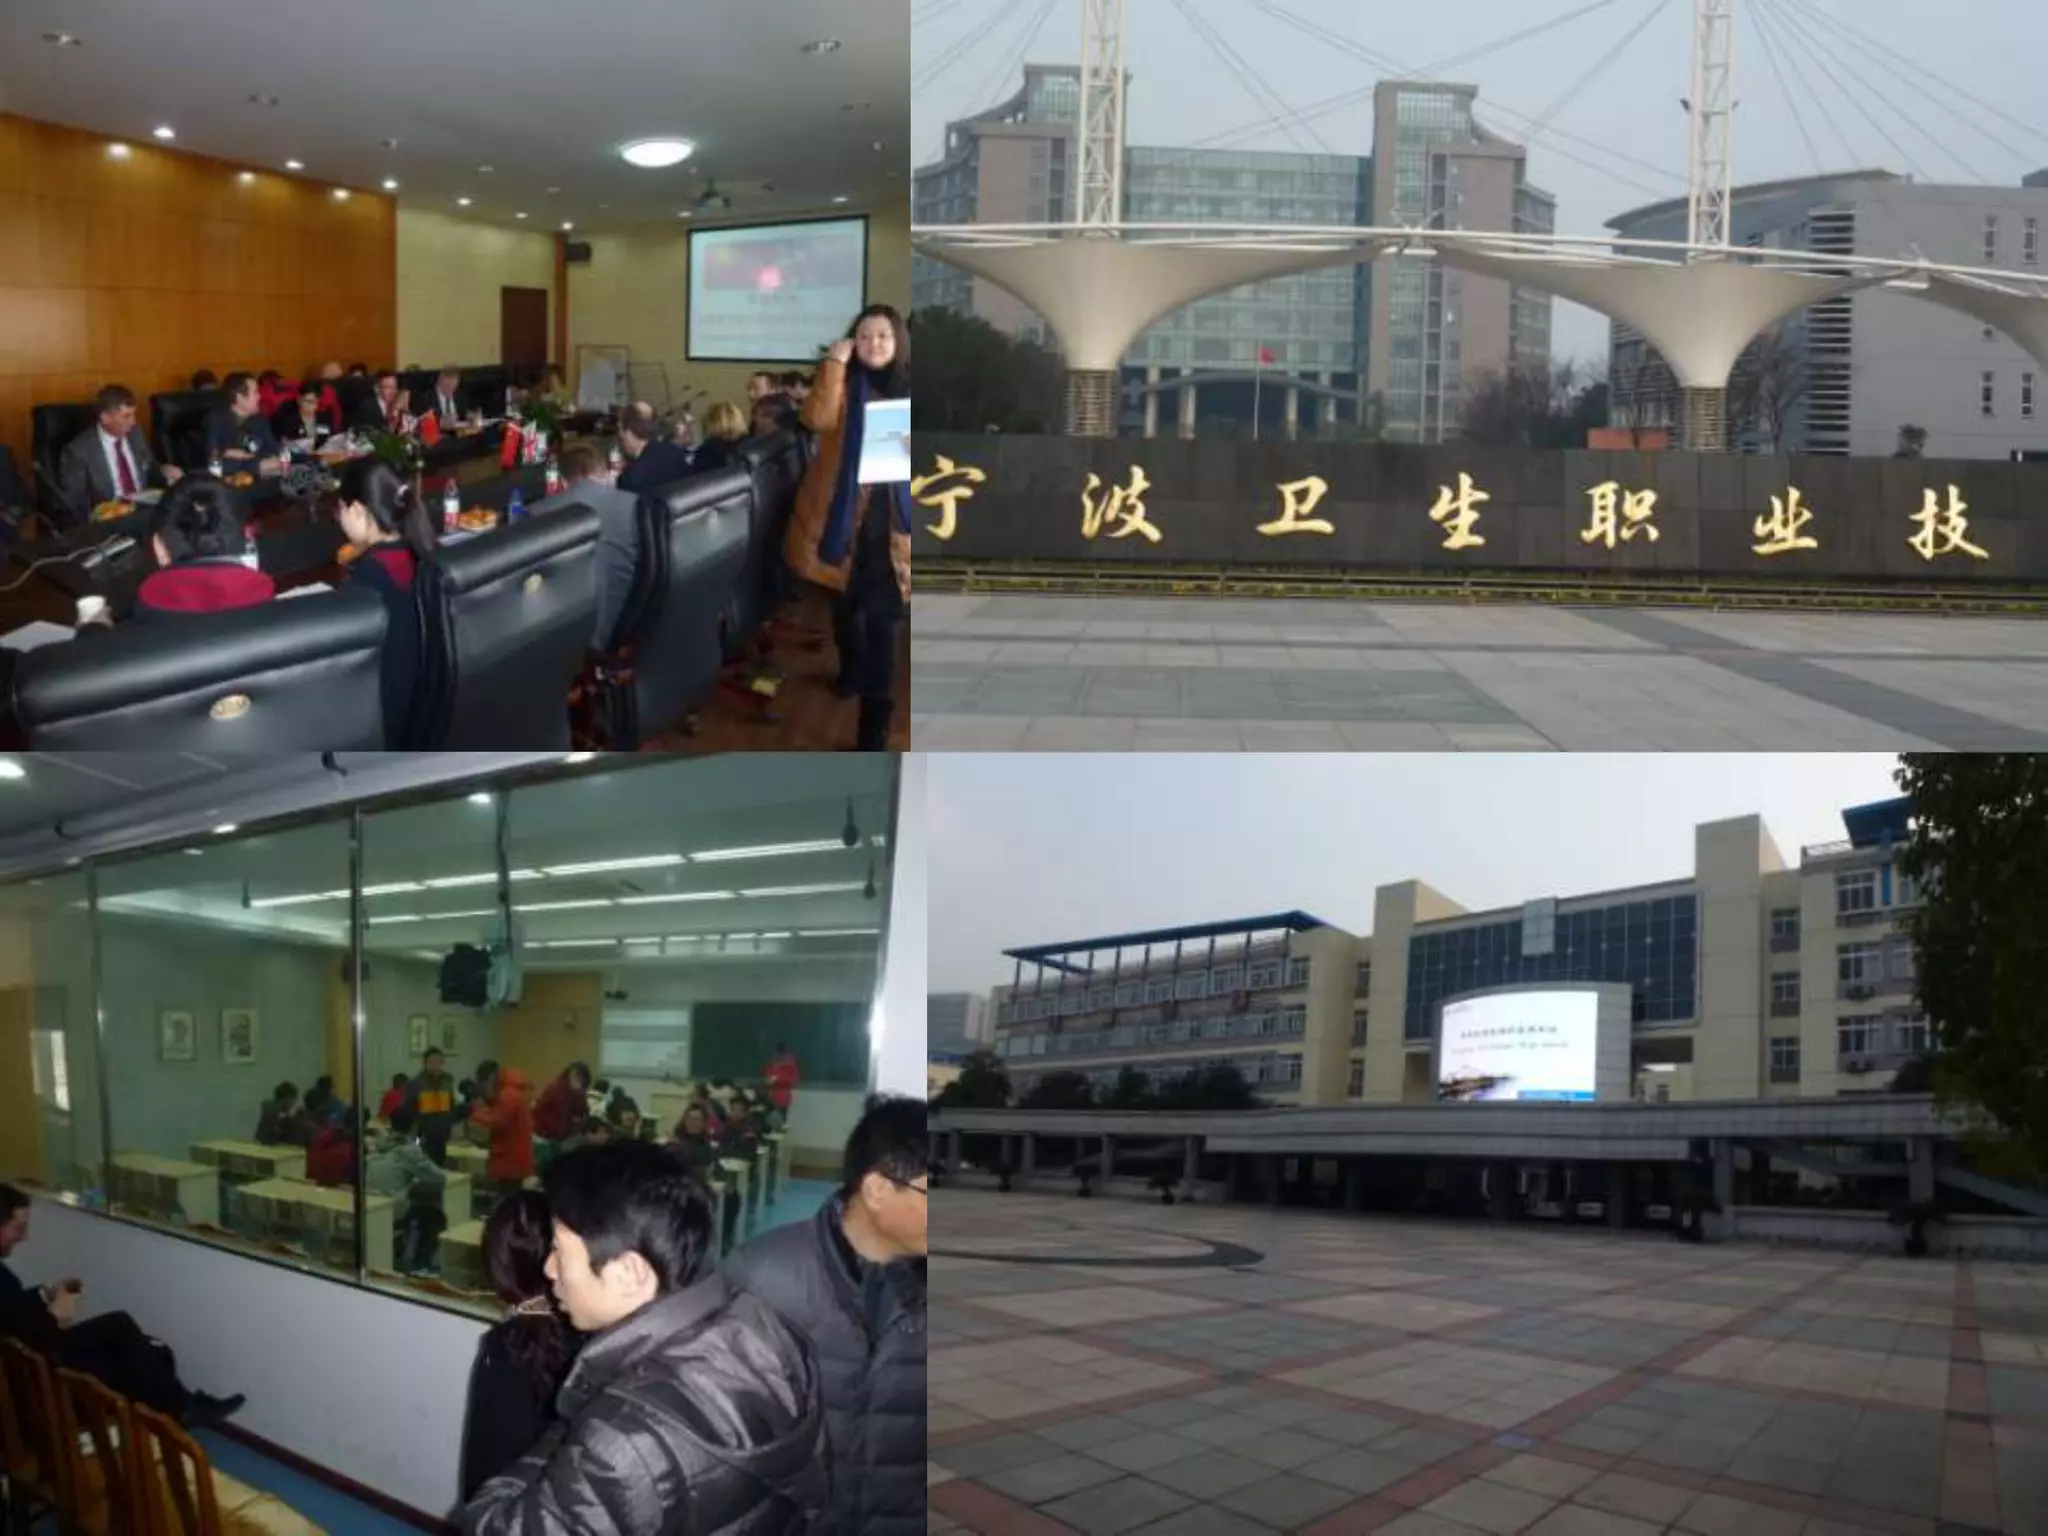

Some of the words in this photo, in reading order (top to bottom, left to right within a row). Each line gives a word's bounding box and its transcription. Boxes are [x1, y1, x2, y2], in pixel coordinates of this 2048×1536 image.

[911, 453, 1990, 561] 宁波卫生职业技
